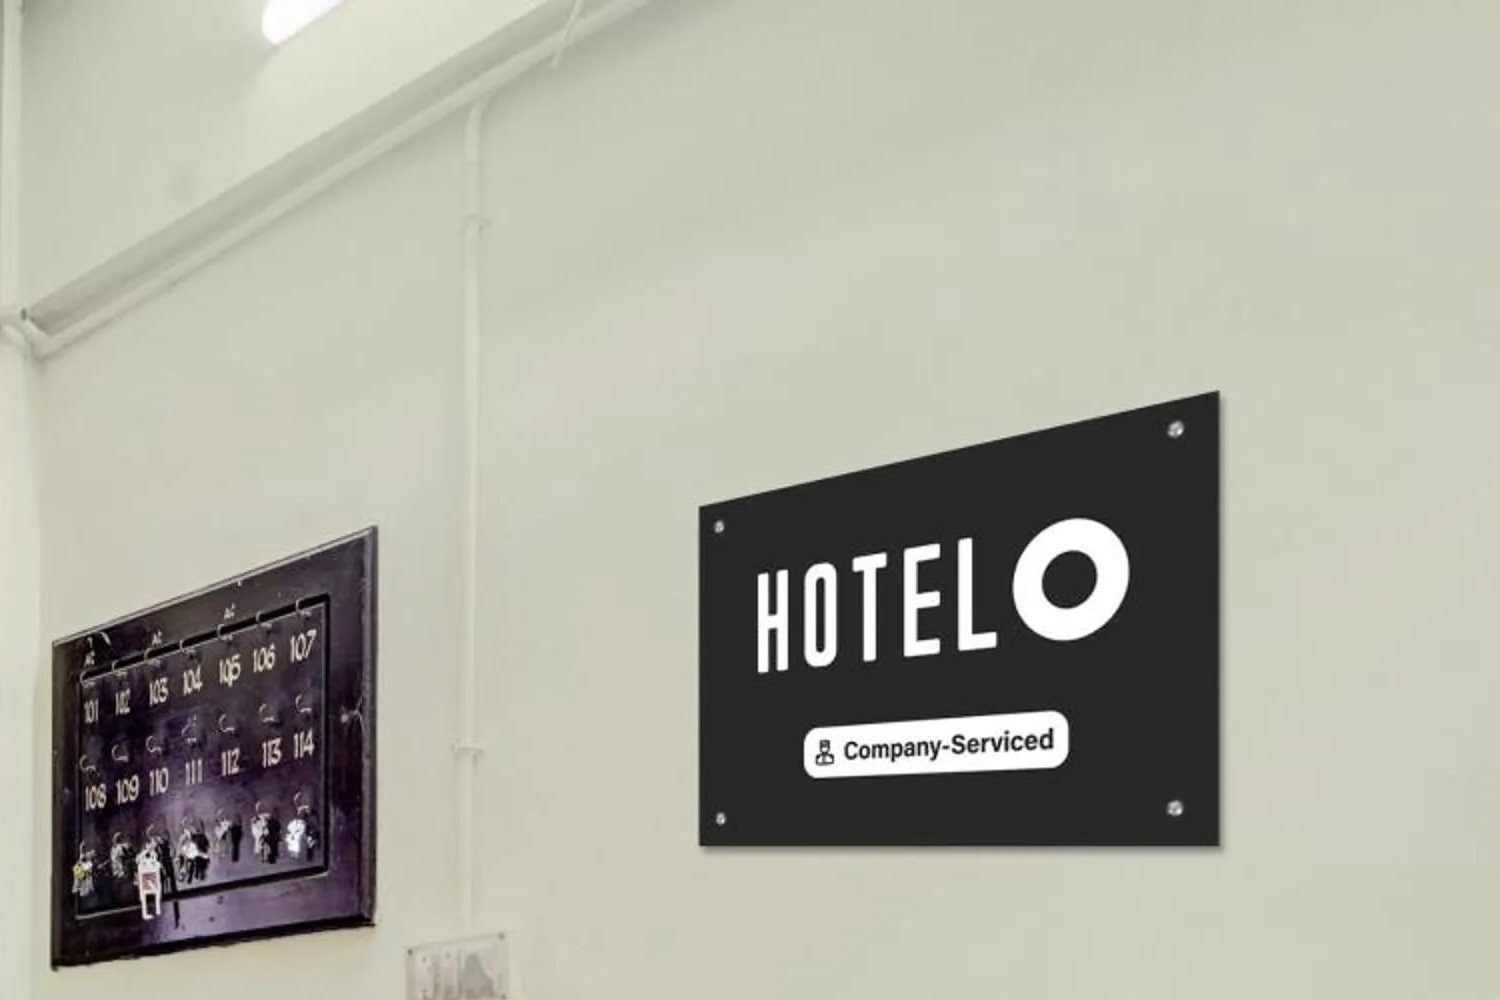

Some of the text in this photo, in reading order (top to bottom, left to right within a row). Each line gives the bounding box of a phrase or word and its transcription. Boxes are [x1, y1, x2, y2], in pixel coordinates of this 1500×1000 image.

[756, 517, 1130, 674] HOTEL O
[83, 628, 317, 724] 101 102 103 104 105 106 107
[85, 727, 315, 812] 108 109 110 111 112 113 114
[843, 727, 1054, 763] Company-Serviced
